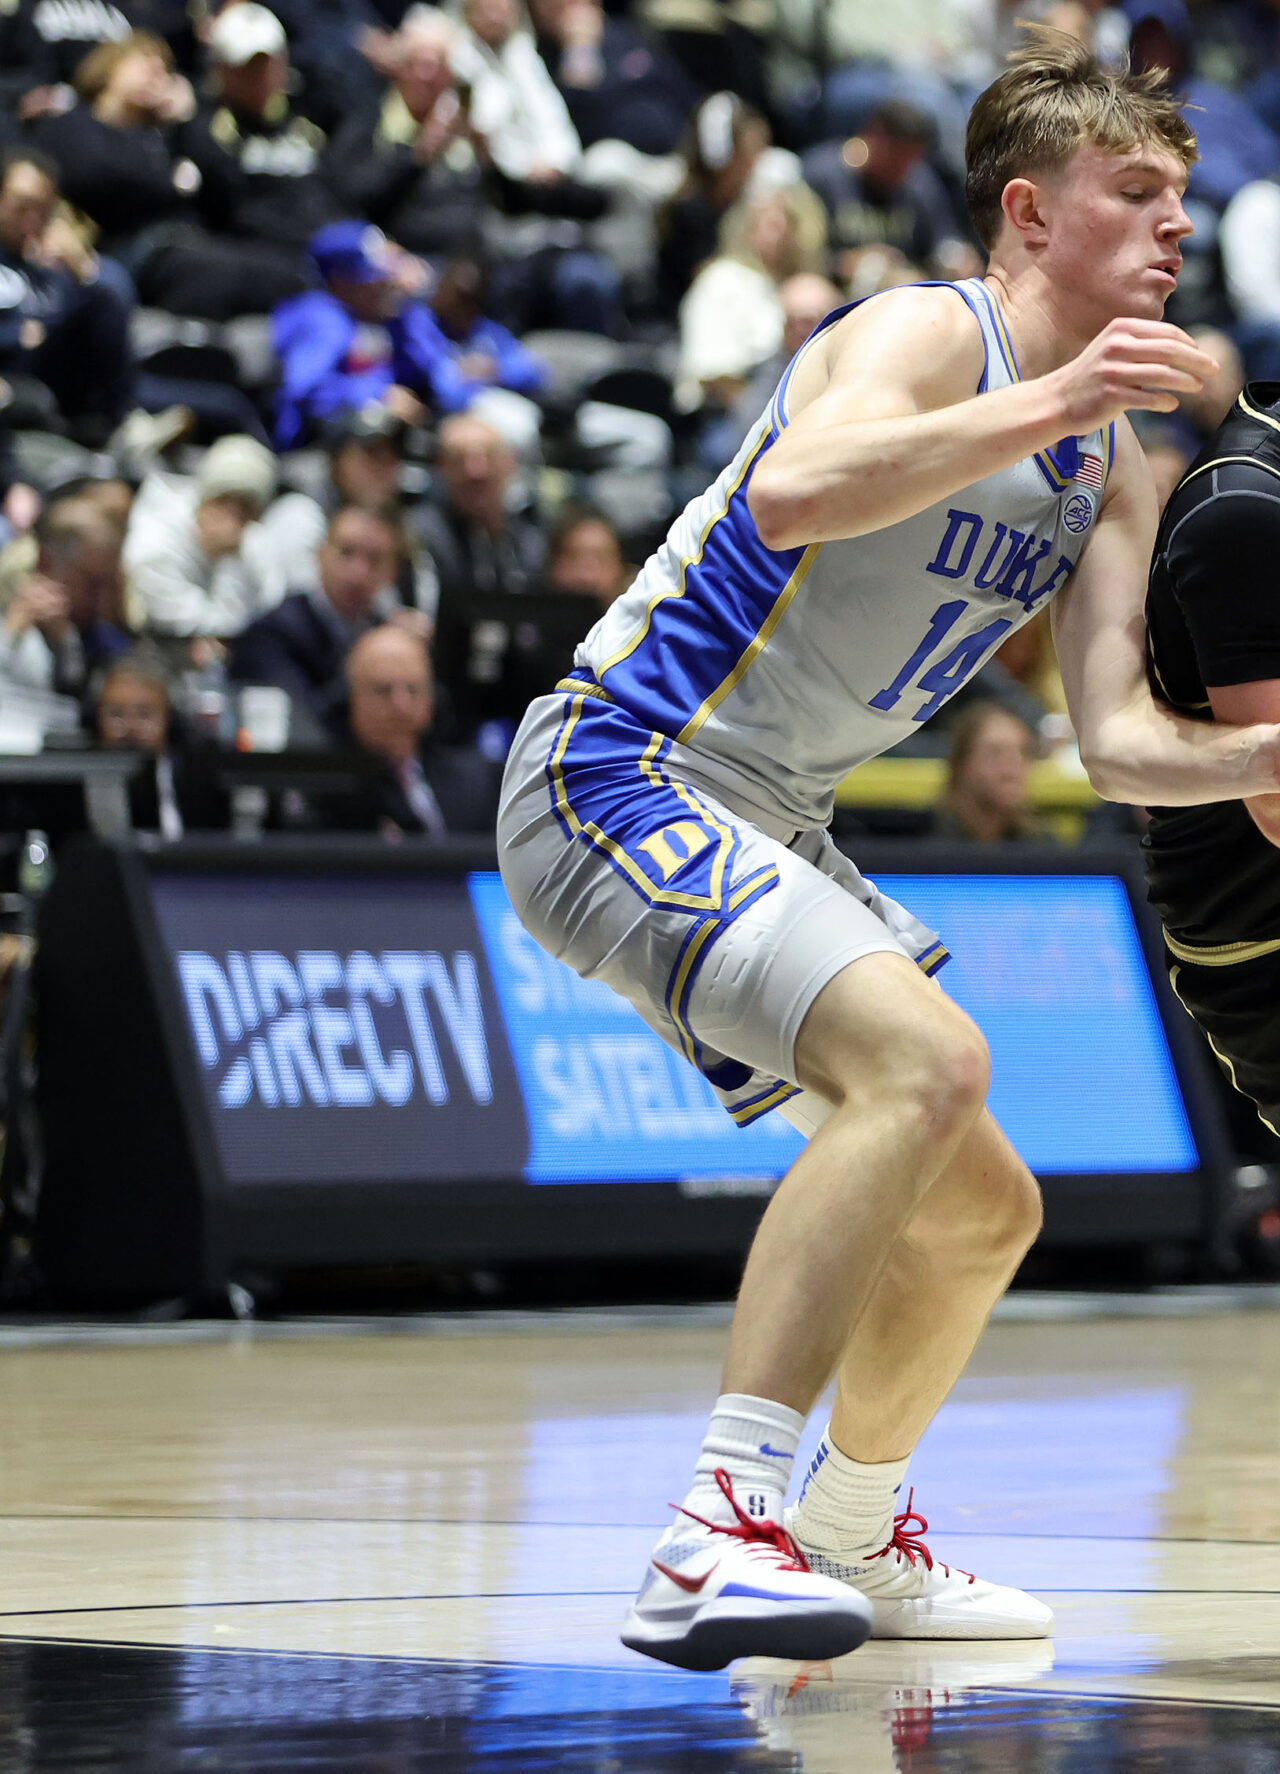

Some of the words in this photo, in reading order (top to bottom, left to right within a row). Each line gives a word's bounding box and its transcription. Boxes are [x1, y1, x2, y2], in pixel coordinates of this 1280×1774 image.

[1068, 506, 1092, 521] ACC
[867, 599, 1013, 722] 14
[175, 948, 494, 1108] DIRECTV
